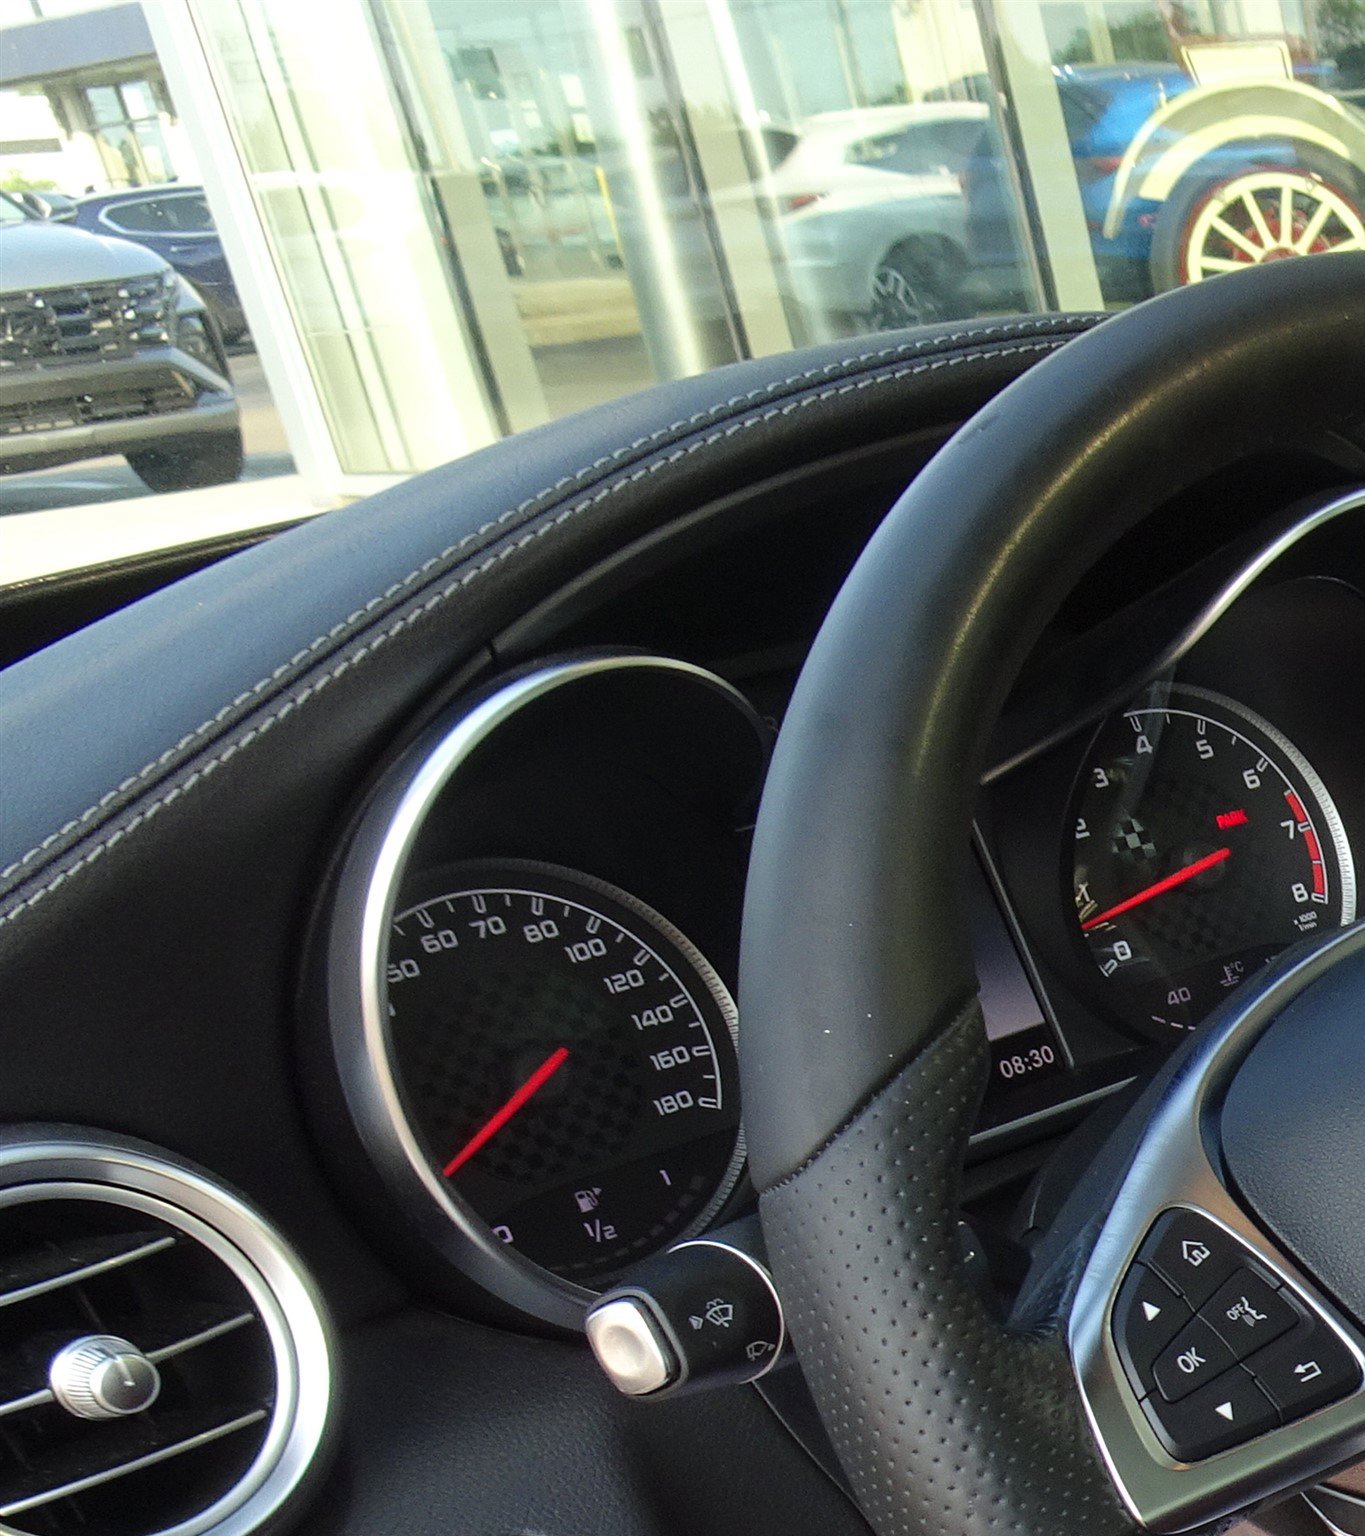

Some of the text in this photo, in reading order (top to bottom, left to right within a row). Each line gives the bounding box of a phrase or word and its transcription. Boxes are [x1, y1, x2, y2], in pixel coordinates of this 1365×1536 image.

[1135, 735, 1154, 755] 4
[1195, 739, 1214, 760] 5
[1093, 767, 1110, 788] 3
[1243, 768, 1262, 789] 6
[1074, 817, 1091, 840] 2
[1279, 819, 1295, 840] 7
[1291, 882, 1310, 903] 8
[468, 915, 507, 939] 70
[523, 919, 560, 943] 80
[420, 929, 459, 954] 60
[564, 938, 608, 964] 100
[1112, 940, 1132, 961] 0
[386, 958, 421, 983] 50
[603, 968, 646, 995] 120
[1166, 986, 1192, 1006] 40
[632, 1003, 675, 1032] 140
[650, 1045, 690, 1072] 160
[999, 1045, 1055, 1079] 08:30
[652, 1089, 695, 1117] 180
[659, 1169, 673, 1187] 1
[583, 1218, 619, 1243] 1/2
[1226, 1302, 1246, 1322] OFF
[1176, 1346, 1206, 1374] OK
